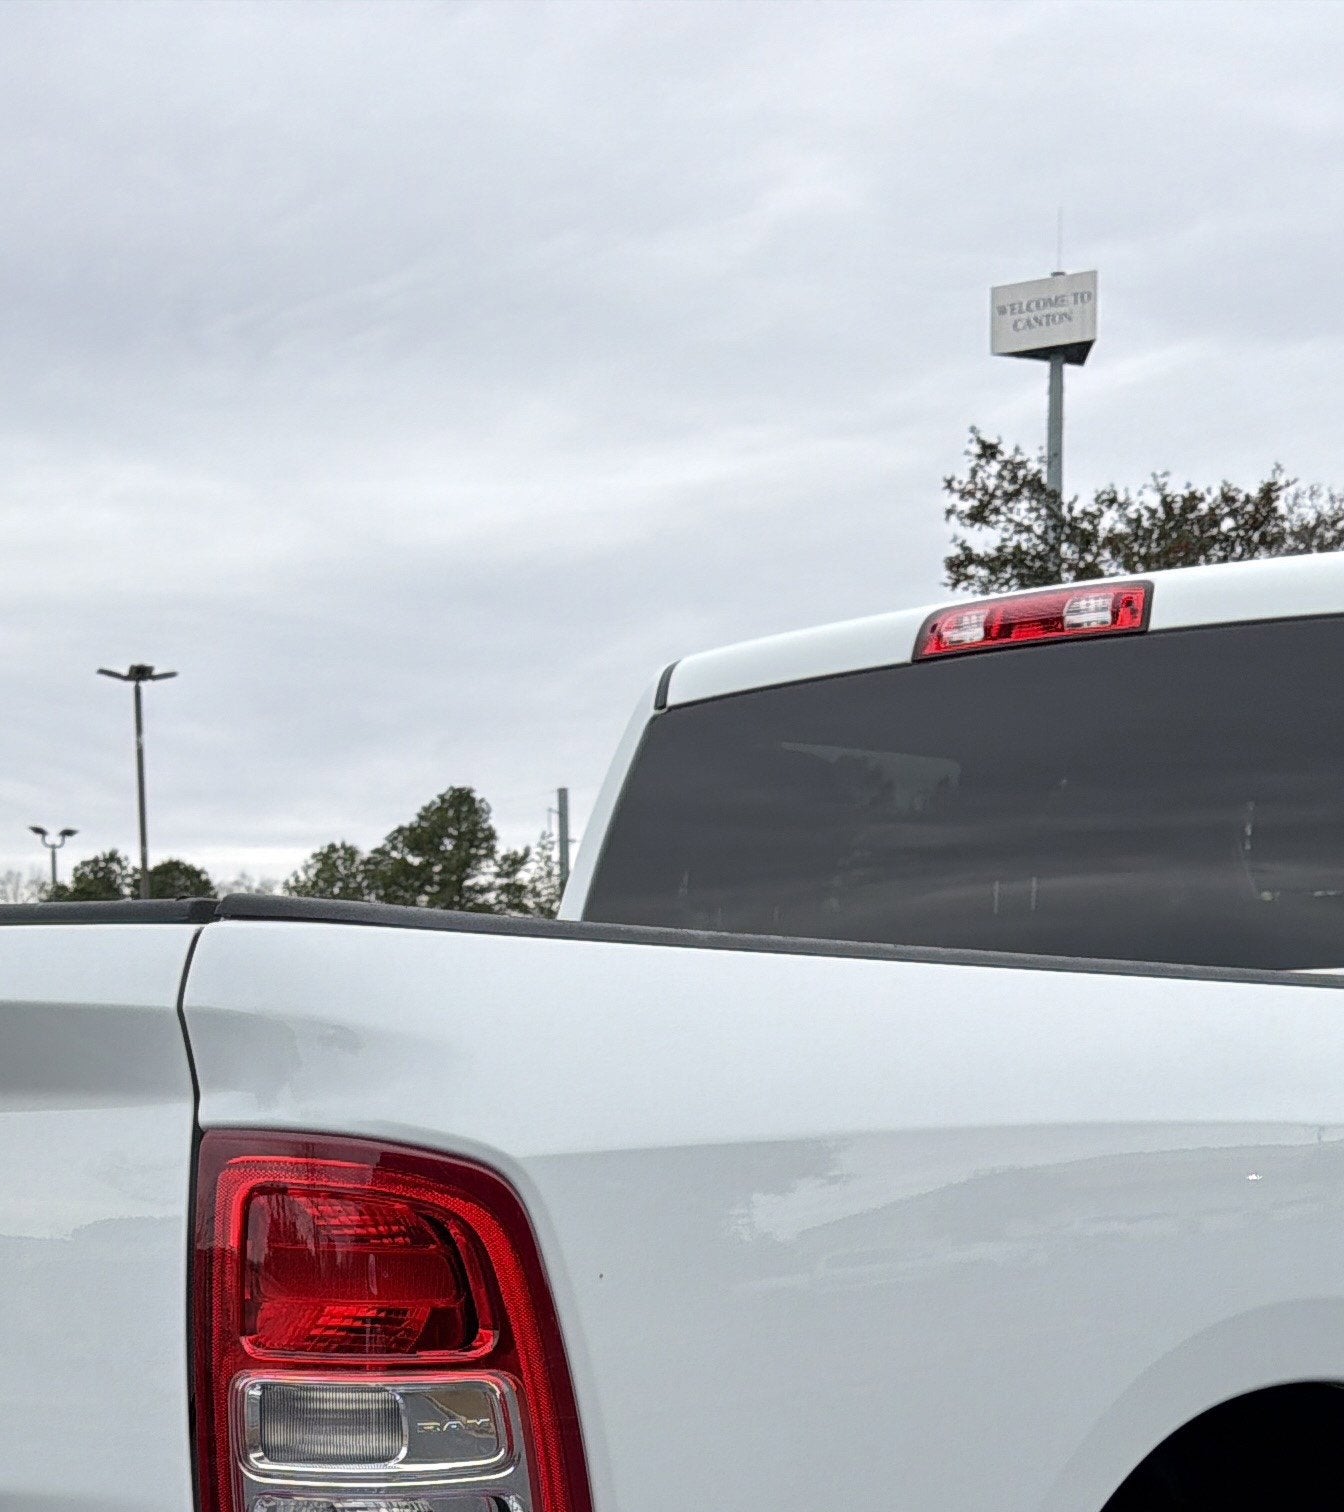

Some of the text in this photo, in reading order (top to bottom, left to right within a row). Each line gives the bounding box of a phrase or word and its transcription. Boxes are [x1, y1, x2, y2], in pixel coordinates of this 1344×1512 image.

[997, 291, 1092, 315] WELCOME TO
[1013, 311, 1073, 332] CANTON
